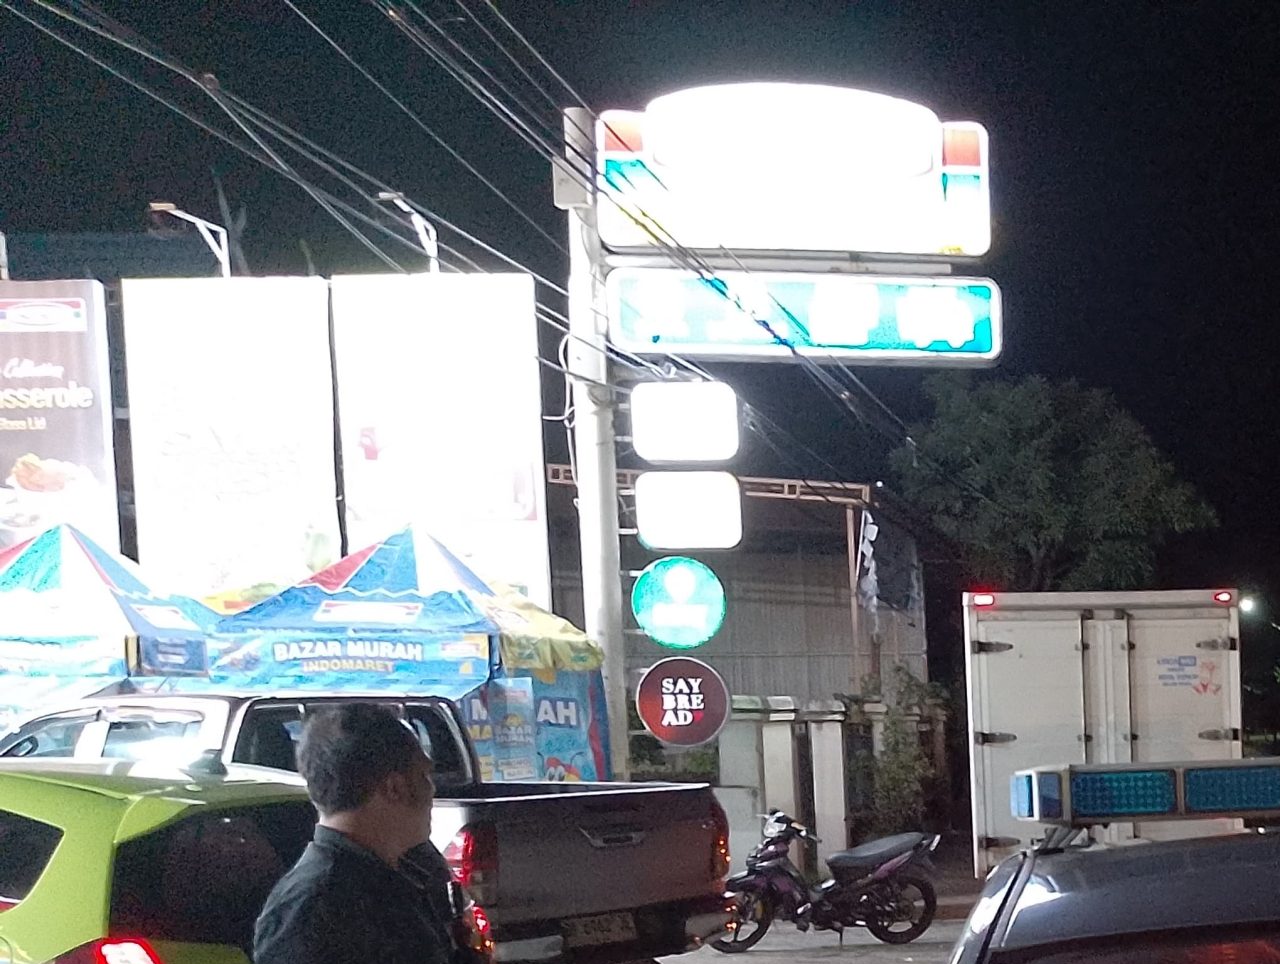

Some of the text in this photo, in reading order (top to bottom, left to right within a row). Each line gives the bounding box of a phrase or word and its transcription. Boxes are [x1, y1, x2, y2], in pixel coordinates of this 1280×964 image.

[273, 640, 423, 661] BAZAR MURAH
[303, 660, 395, 673] INDOMARET
[661, 677, 702, 694] SAY
[662, 695, 704, 710] BRE
[661, 709, 694, 727] AD
